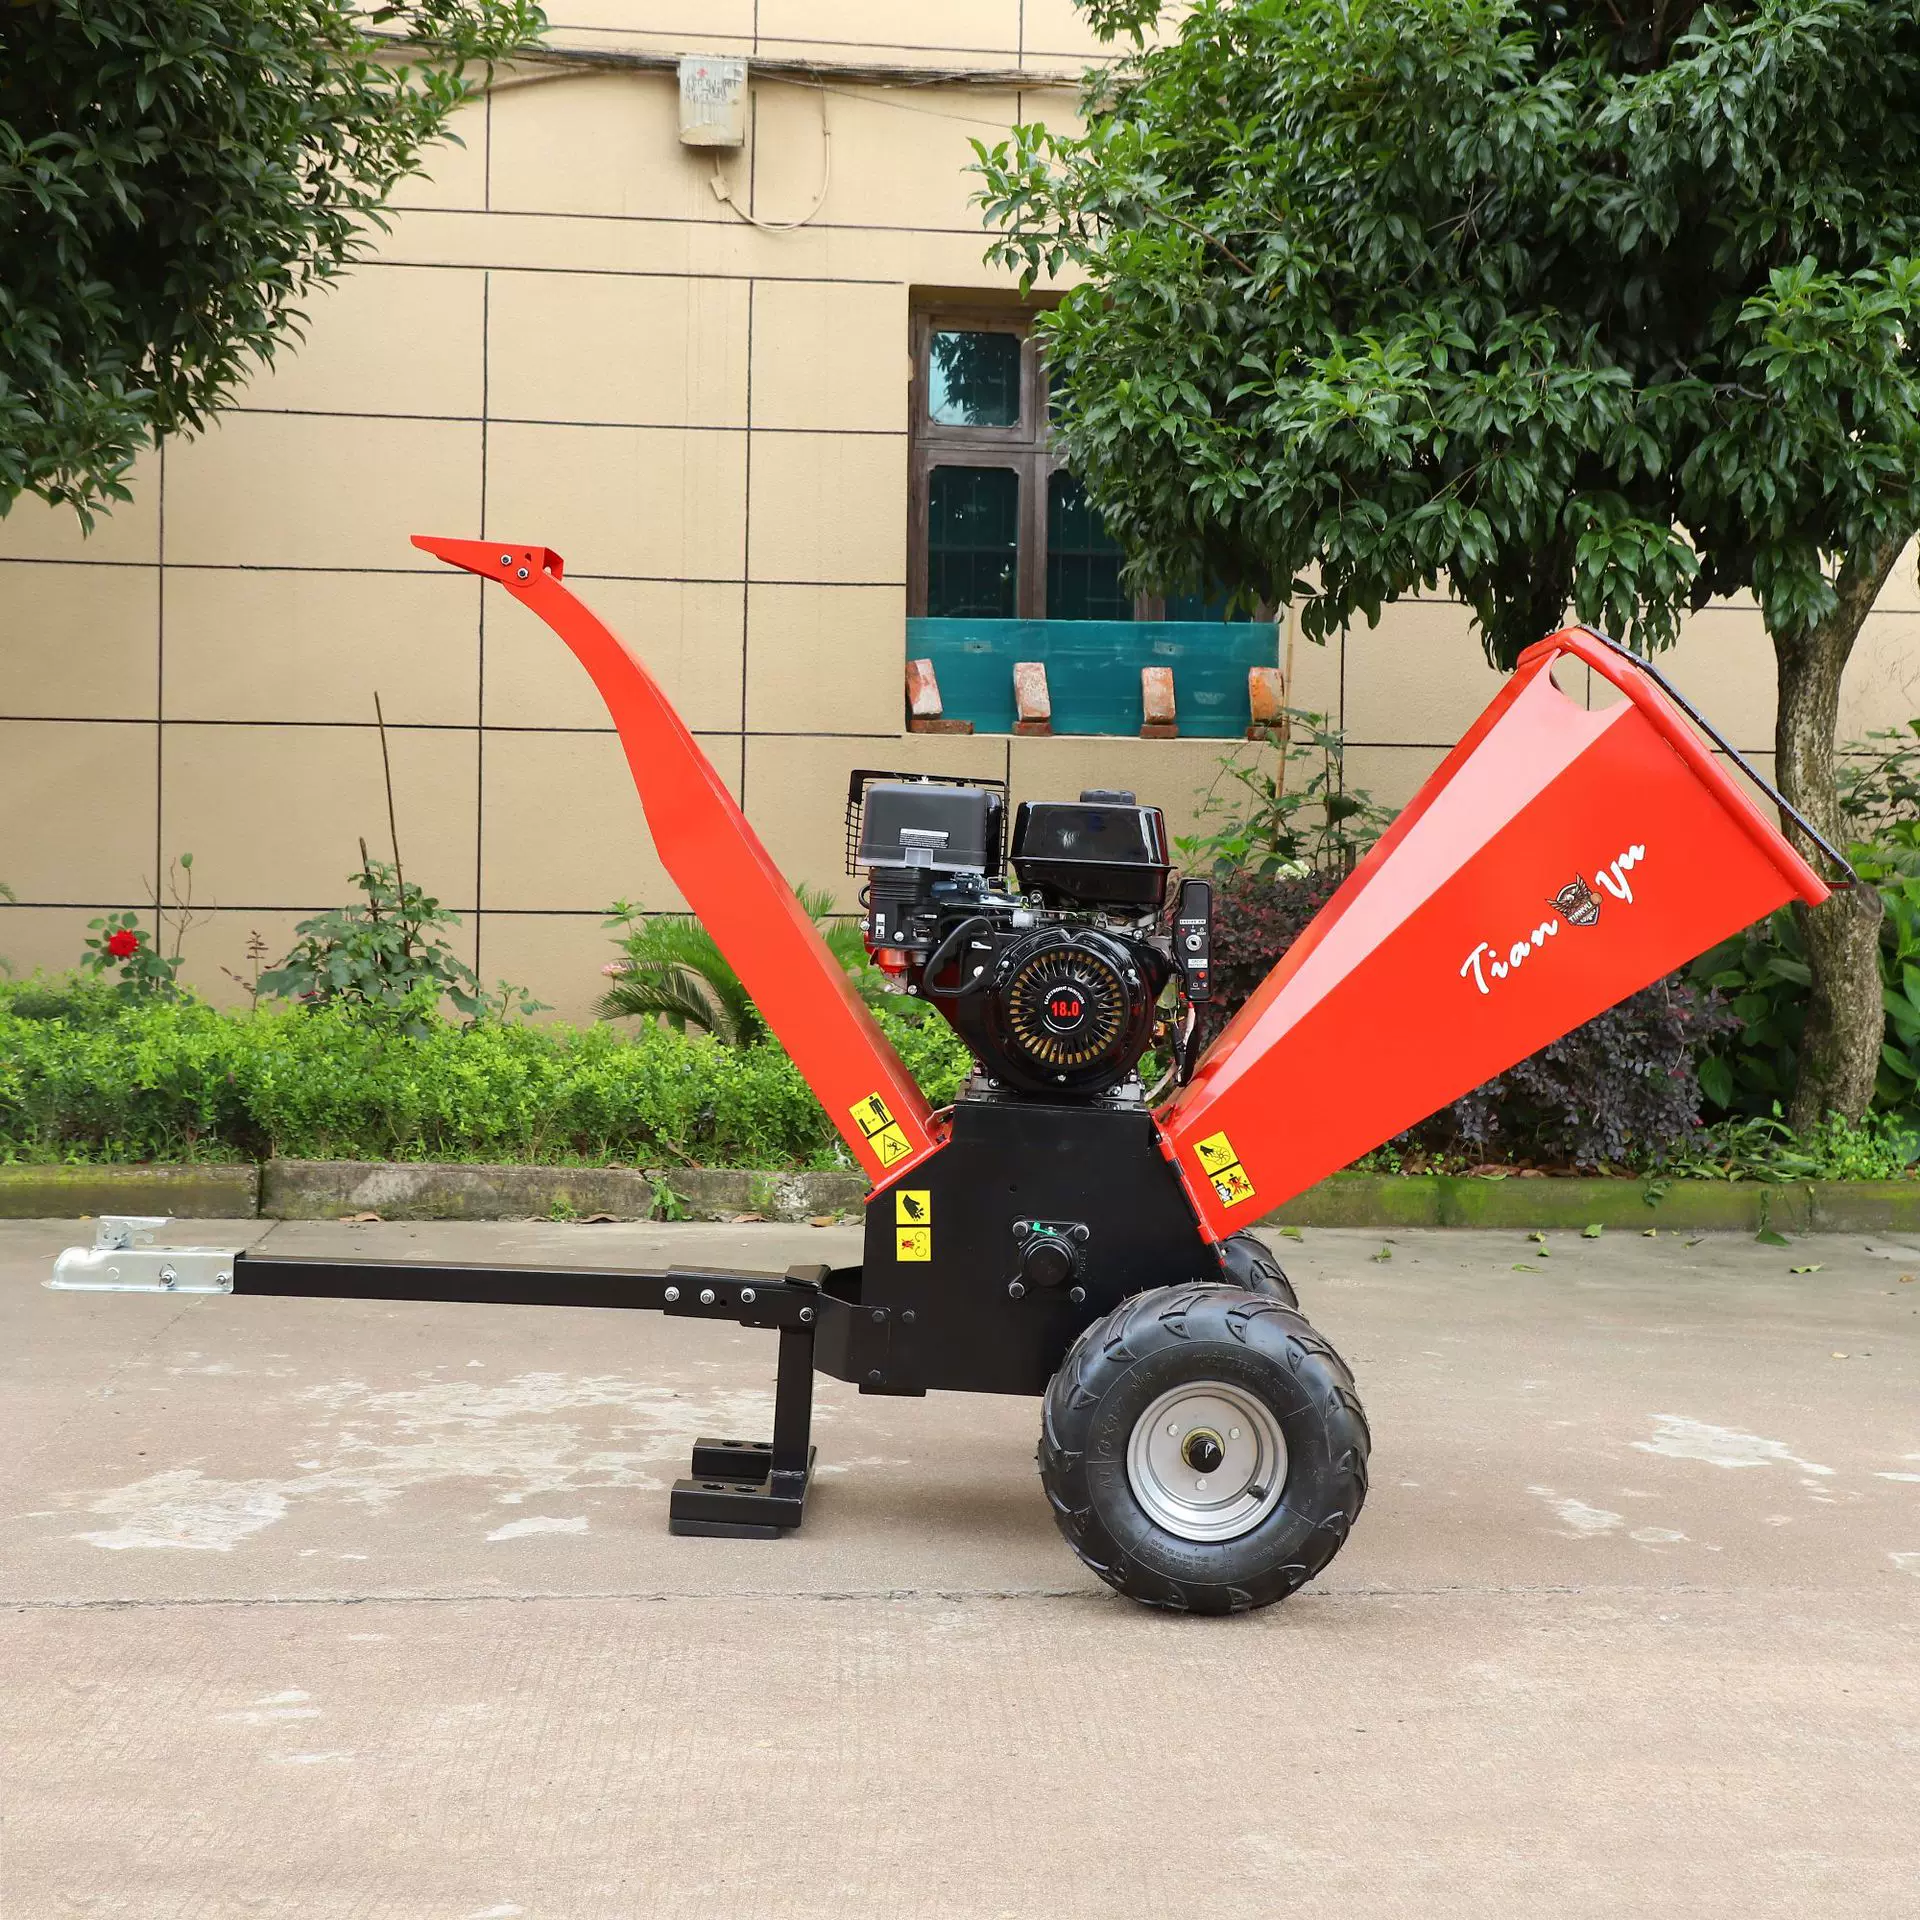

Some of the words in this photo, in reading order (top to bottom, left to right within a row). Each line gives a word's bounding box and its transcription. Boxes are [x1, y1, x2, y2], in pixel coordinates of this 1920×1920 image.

[1460, 919, 1558, 994] Tian
[1044, 985, 1067, 1004] ELECTRONIC
[1067, 986, 1085, 1004] IGNITION
[1051, 1001, 1079, 1017] 18.0
